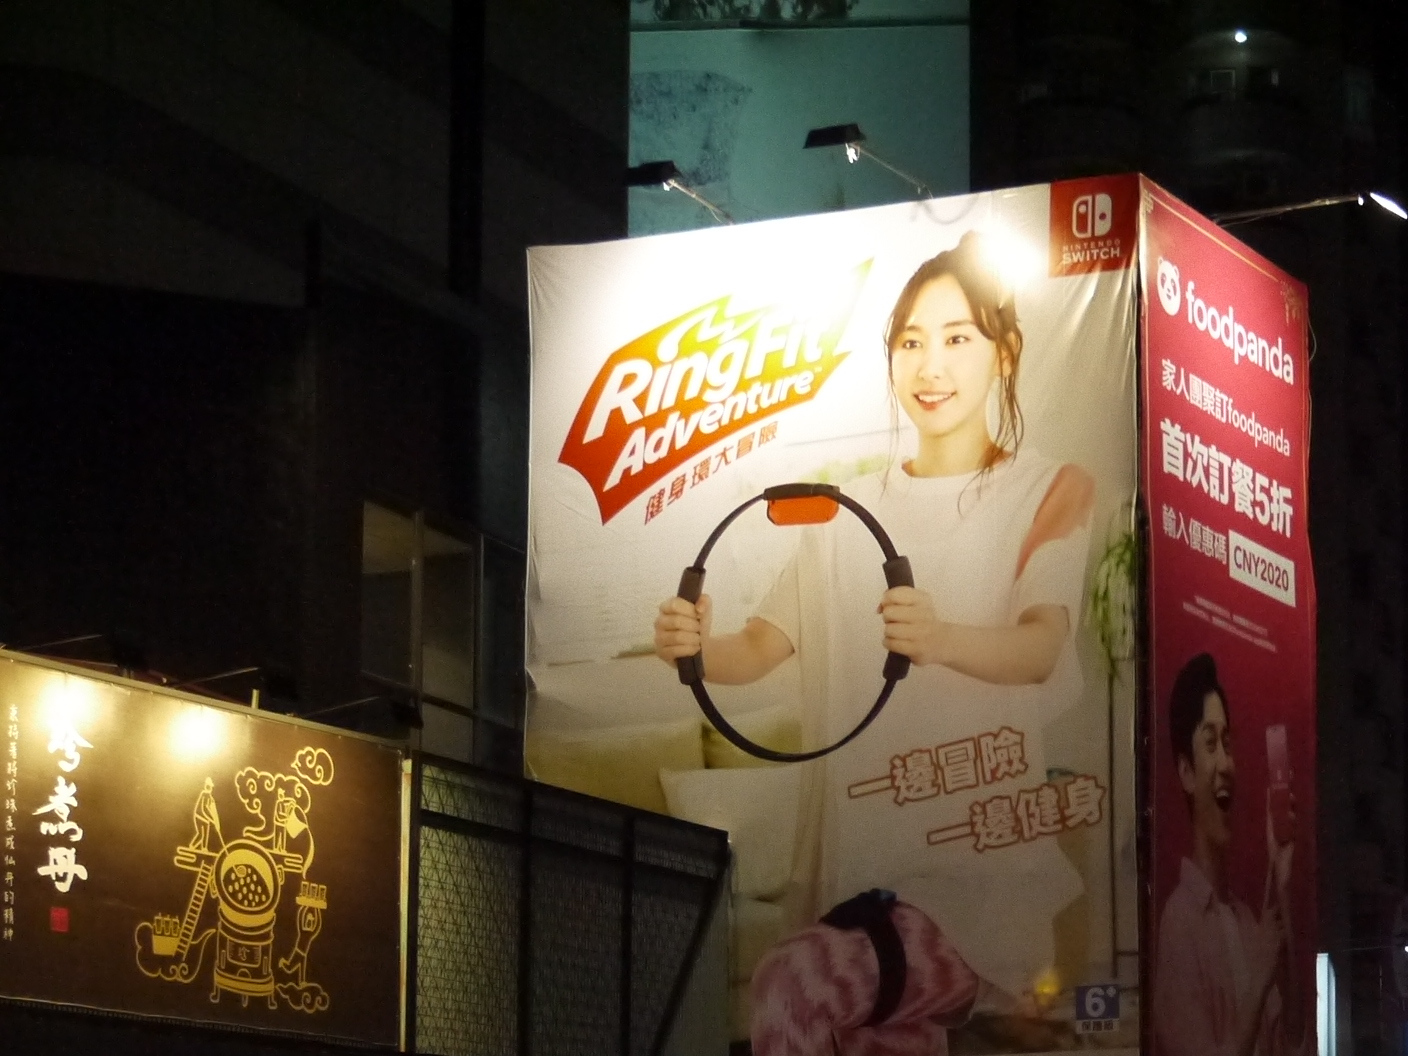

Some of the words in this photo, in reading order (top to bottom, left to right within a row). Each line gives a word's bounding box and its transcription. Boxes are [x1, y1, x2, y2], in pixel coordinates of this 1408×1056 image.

[1062, 247, 1121, 265] SWITCH
[1063, 238, 1121, 251] NINTENDO
[1186, 281, 1294, 385] foodpanda
[603, 369, 814, 492] Adventure
[1161, 359, 1290, 457] 家人團聚訂foodpanda
[644, 421, 778, 525] 健身環大冒險
[1160, 418, 1294, 538] 首次訂餐5折
[1162, 503, 1228, 565] 輸入優惠碼
[1233, 545, 1289, 592] CNY2020
[848, 726, 1029, 806] 一邊冒險
[927, 773, 1106, 853] 一邊健身
